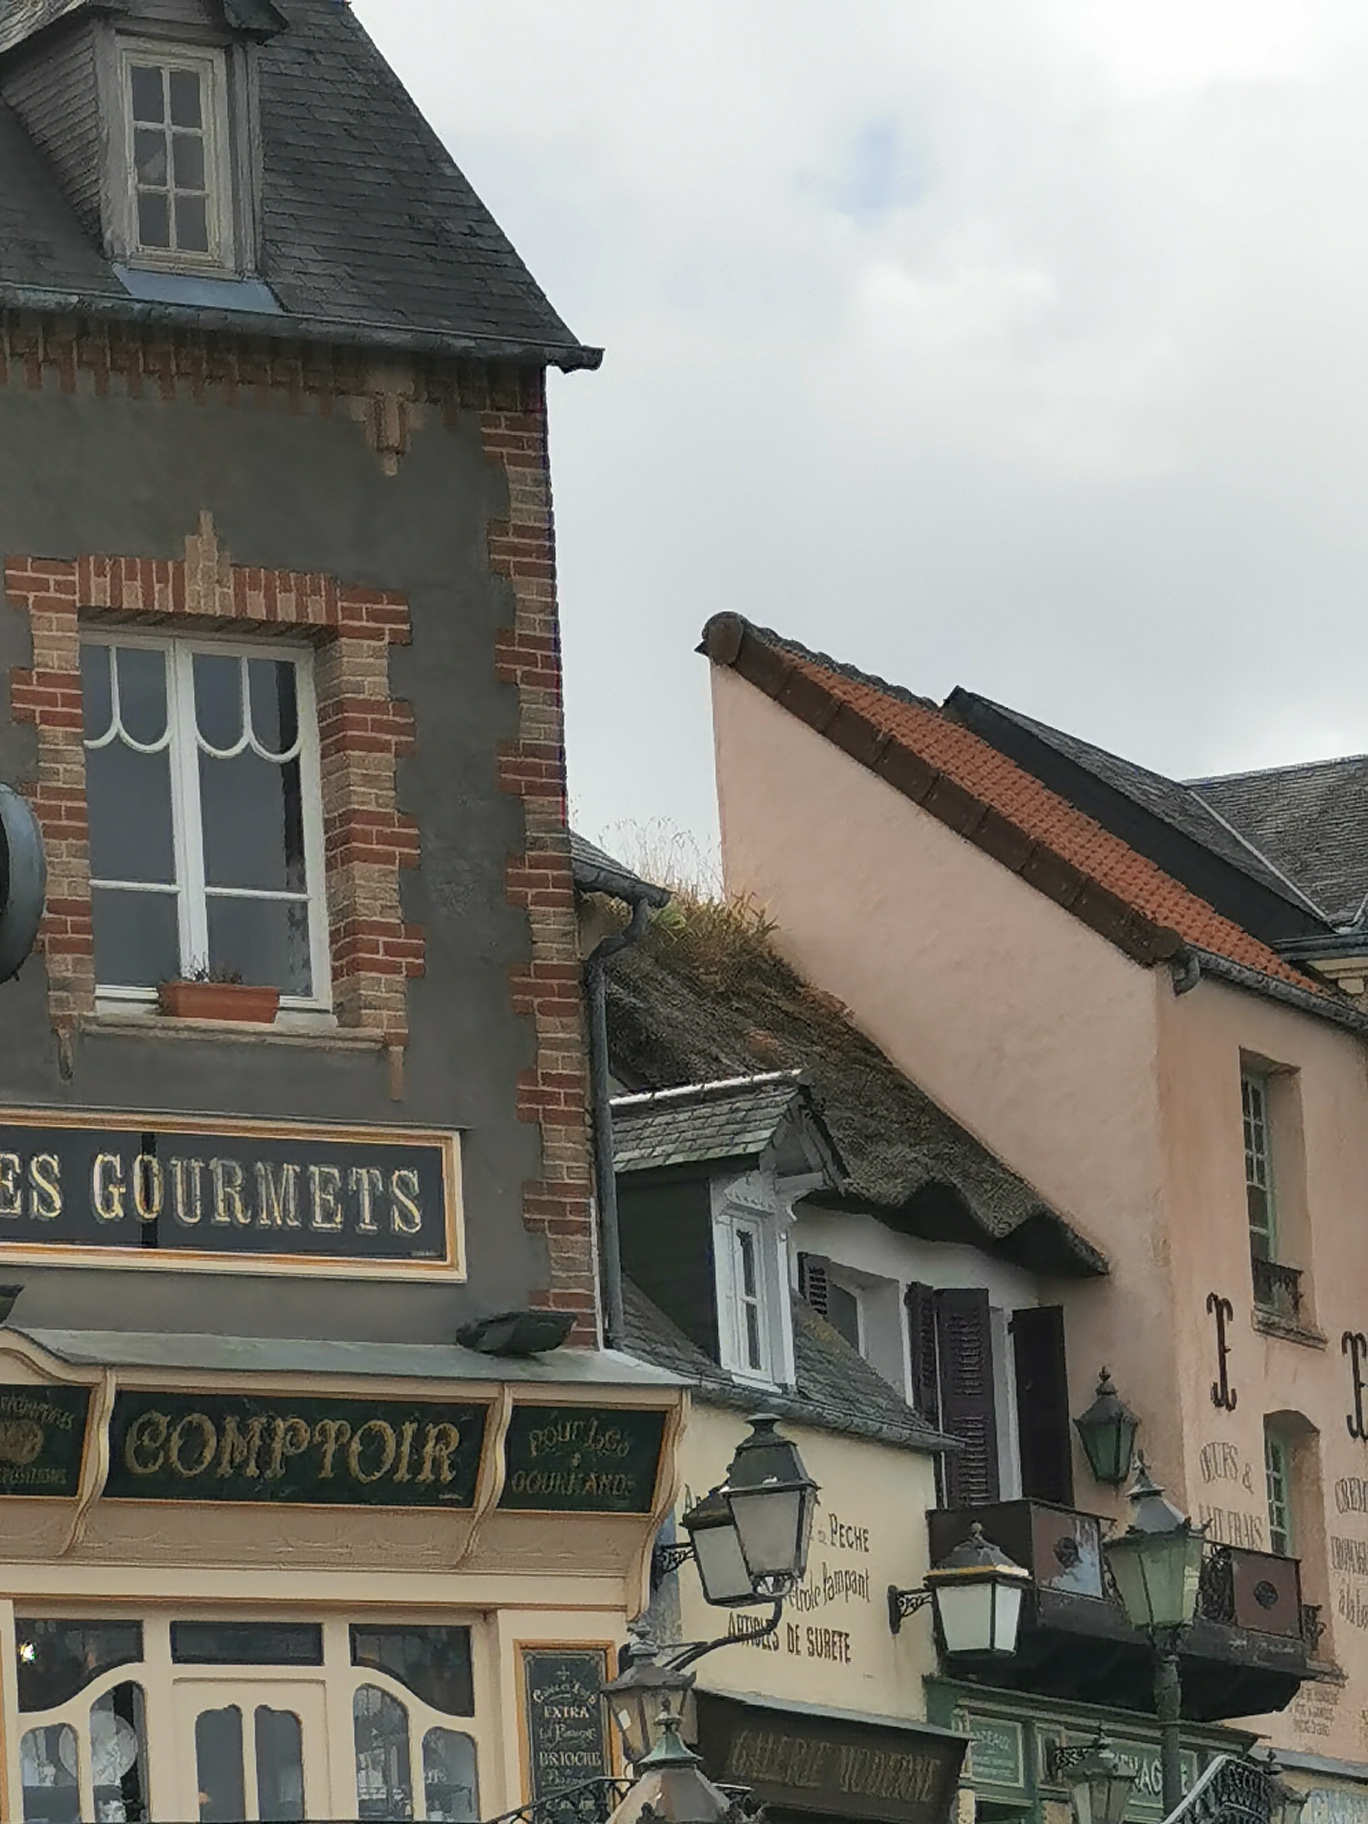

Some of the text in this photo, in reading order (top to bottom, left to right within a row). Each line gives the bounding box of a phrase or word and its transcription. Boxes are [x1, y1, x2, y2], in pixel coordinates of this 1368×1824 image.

[90, 1152, 425, 1238] GOURMETS
[124, 1408, 461, 1487] COMPTOIR
[1241, 1462, 1255, 1495] &
[786, 1621, 802, 1656] DE
[539, 1750, 603, 1768] BRIOCHE
